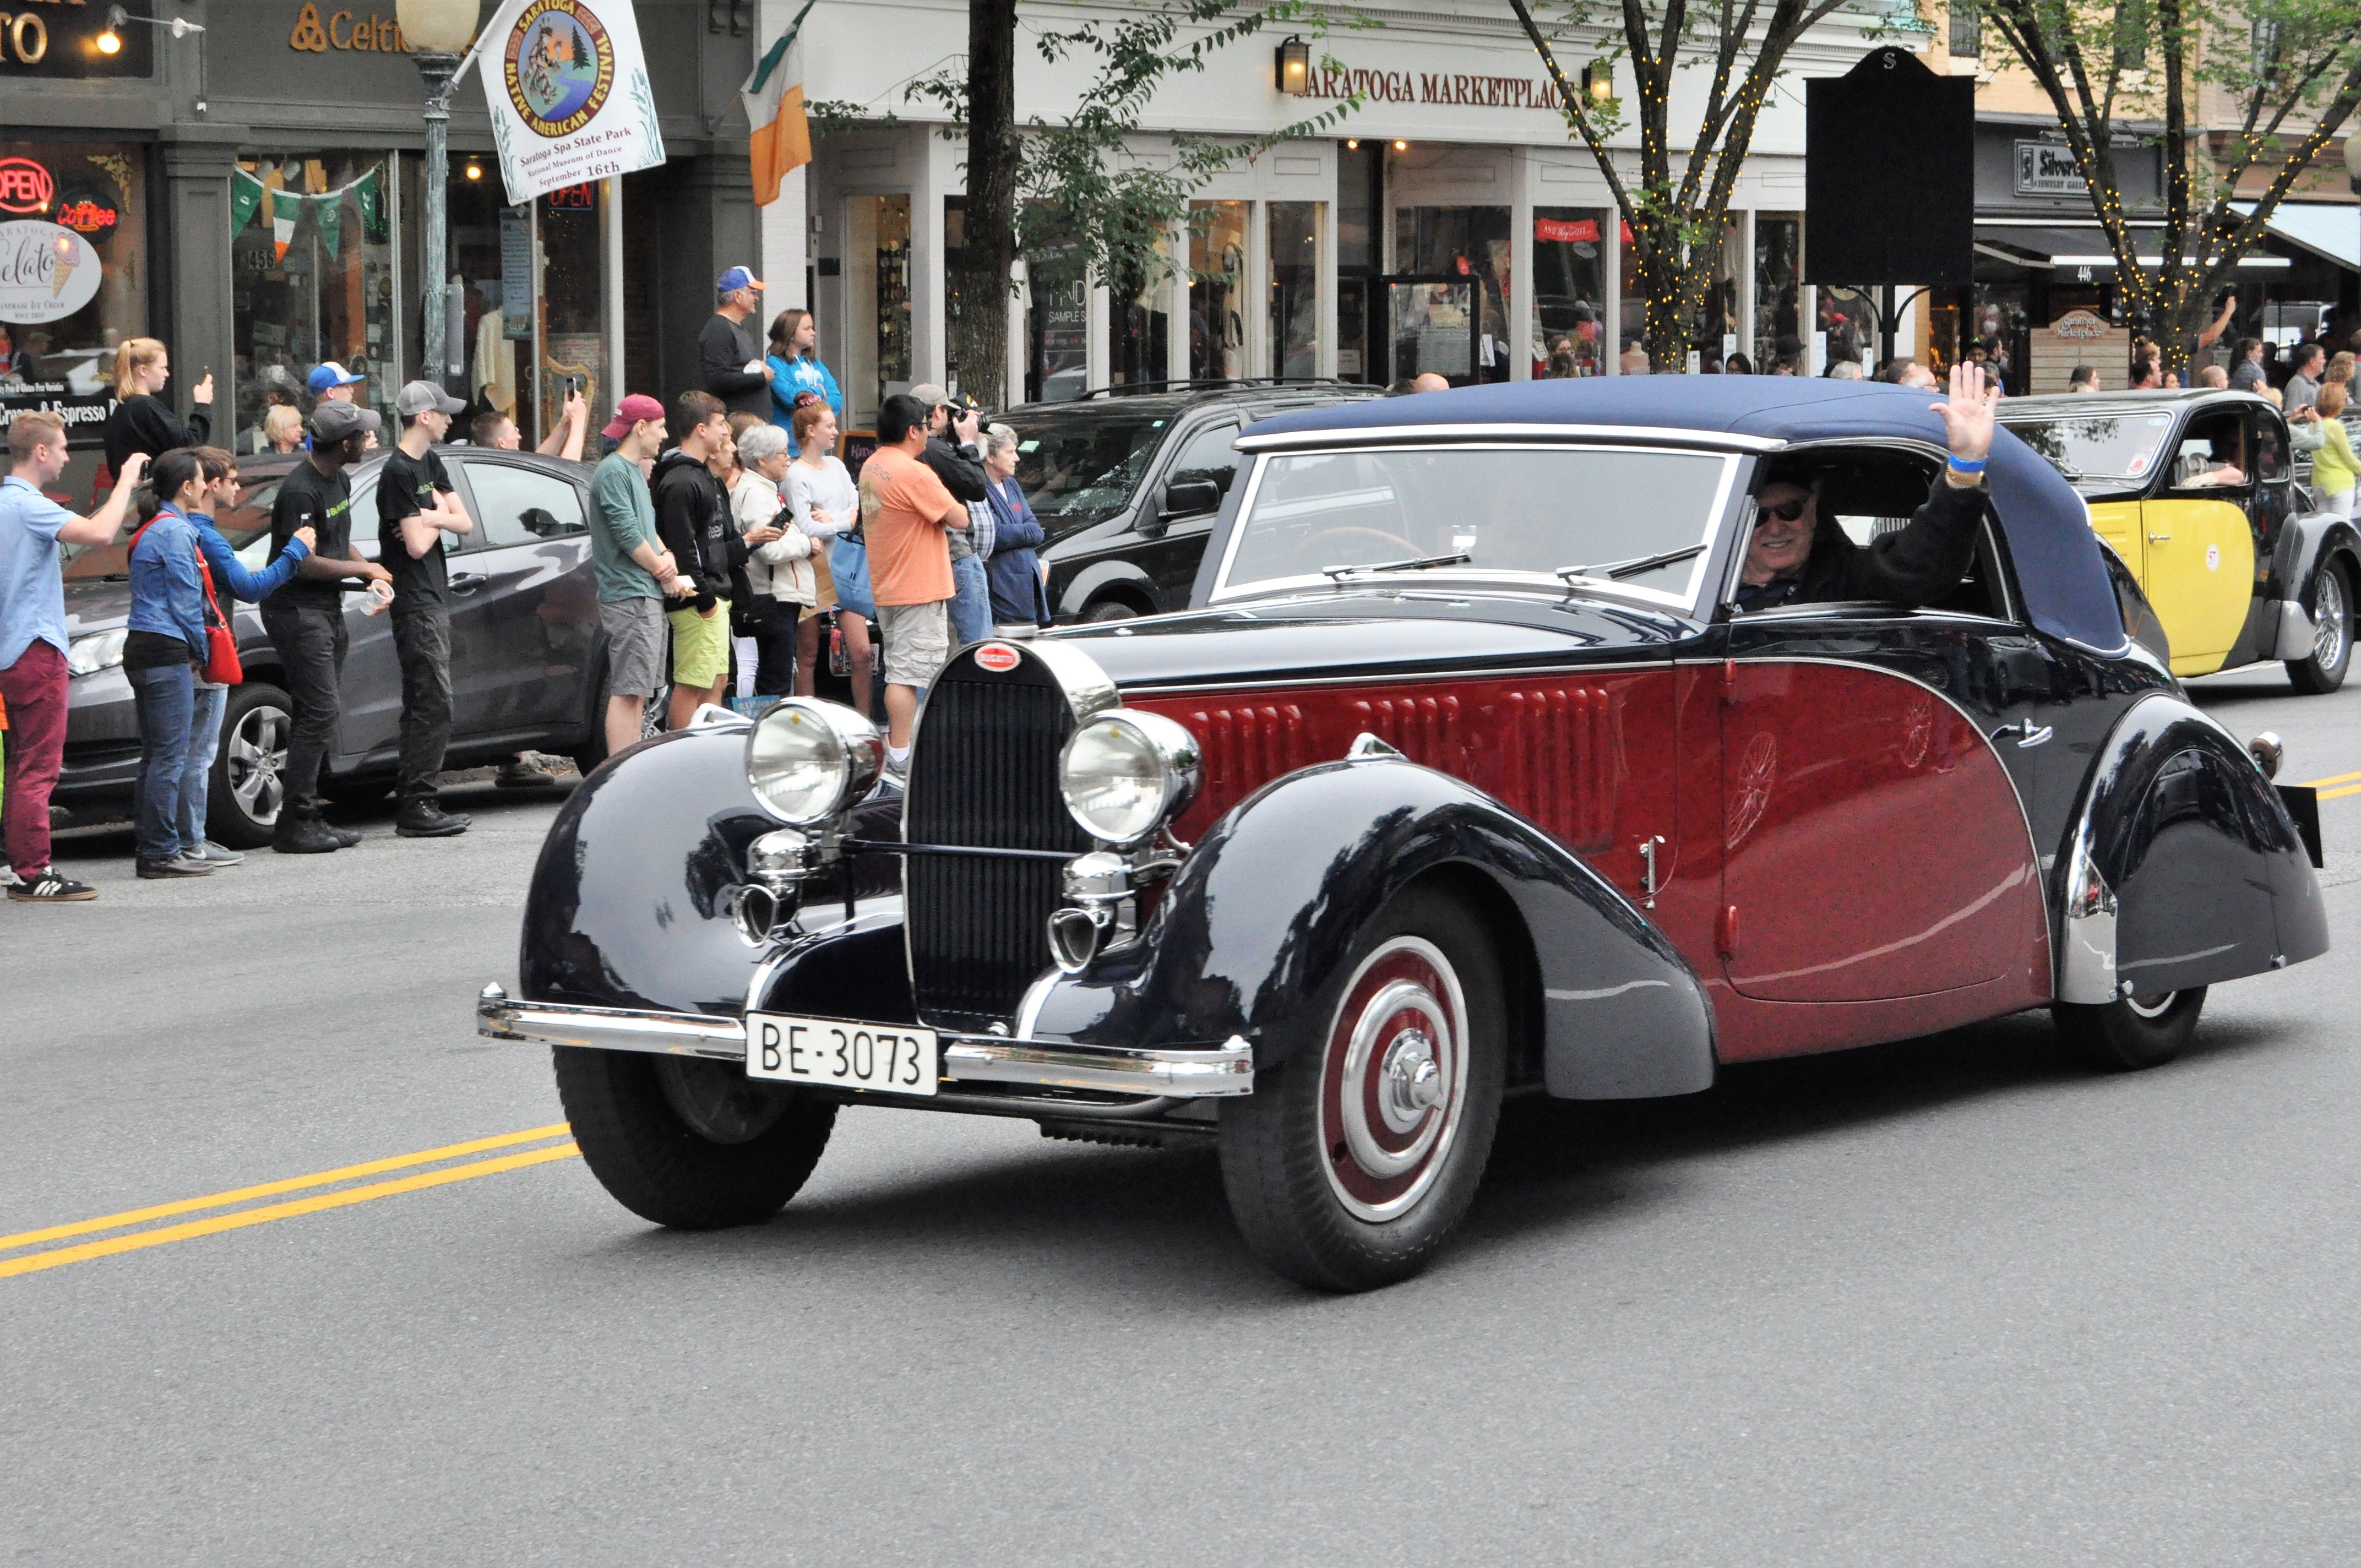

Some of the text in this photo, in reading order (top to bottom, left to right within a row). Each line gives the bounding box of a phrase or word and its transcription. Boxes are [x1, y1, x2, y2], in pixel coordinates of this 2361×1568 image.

[519, 0, 574, 31] SARATOGA
[587, 32, 613, 110] FESTIVAL
[1294, 66, 1415, 102] ARATOGA
[505, 62, 531, 119] NATIVE
[531, 109, 589, 136] AMERICAN
[520, 127, 632, 167] Saratoga Spa State Park
[527, 145, 623, 179] National Museum of Dance
[538, 160, 621, 187] September 16th
[2039, 148, 2077, 177] Silver
[0, 170, 46, 199] PEN
[551, 181, 592, 207] OPEN
[57, 203, 116, 226] Coffee
[0, 236, 54, 285] elato
[250, 249, 274, 268] 456
[2077, 266, 2091, 281] 446
[1048, 311, 1079, 323] SAMPLE
[2058, 328, 2102, 339] Marketplace
[53, 400, 106, 427] Espresso
[2208, 551, 2216, 564] 57
[980, 653, 1014, 663] BUGATTI
[763, 1022, 920, 1085] BE-3073
